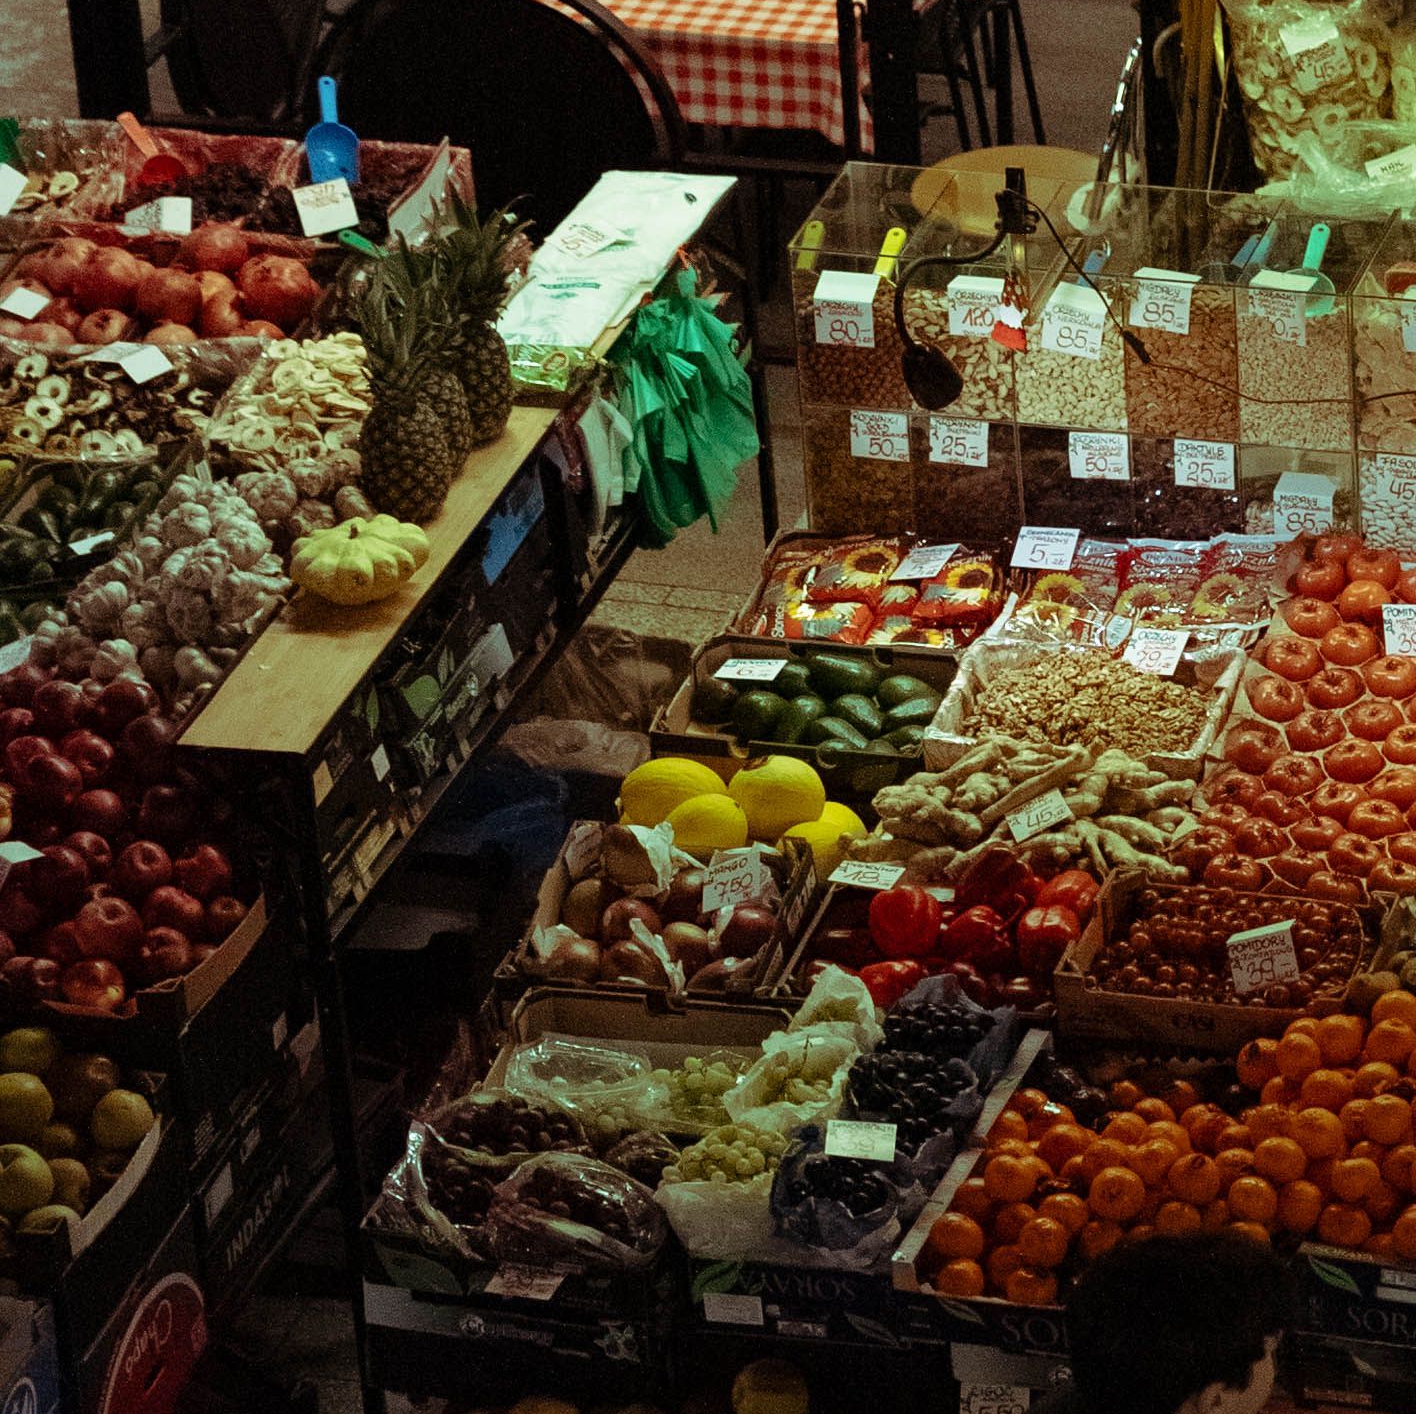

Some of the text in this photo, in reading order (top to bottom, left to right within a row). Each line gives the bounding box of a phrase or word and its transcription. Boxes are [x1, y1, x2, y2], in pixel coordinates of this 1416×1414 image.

[709, 858, 748, 876] MANGO
[1228, 934, 1287, 954] POMIDORY
[1002, 1313, 1070, 1348] SO
